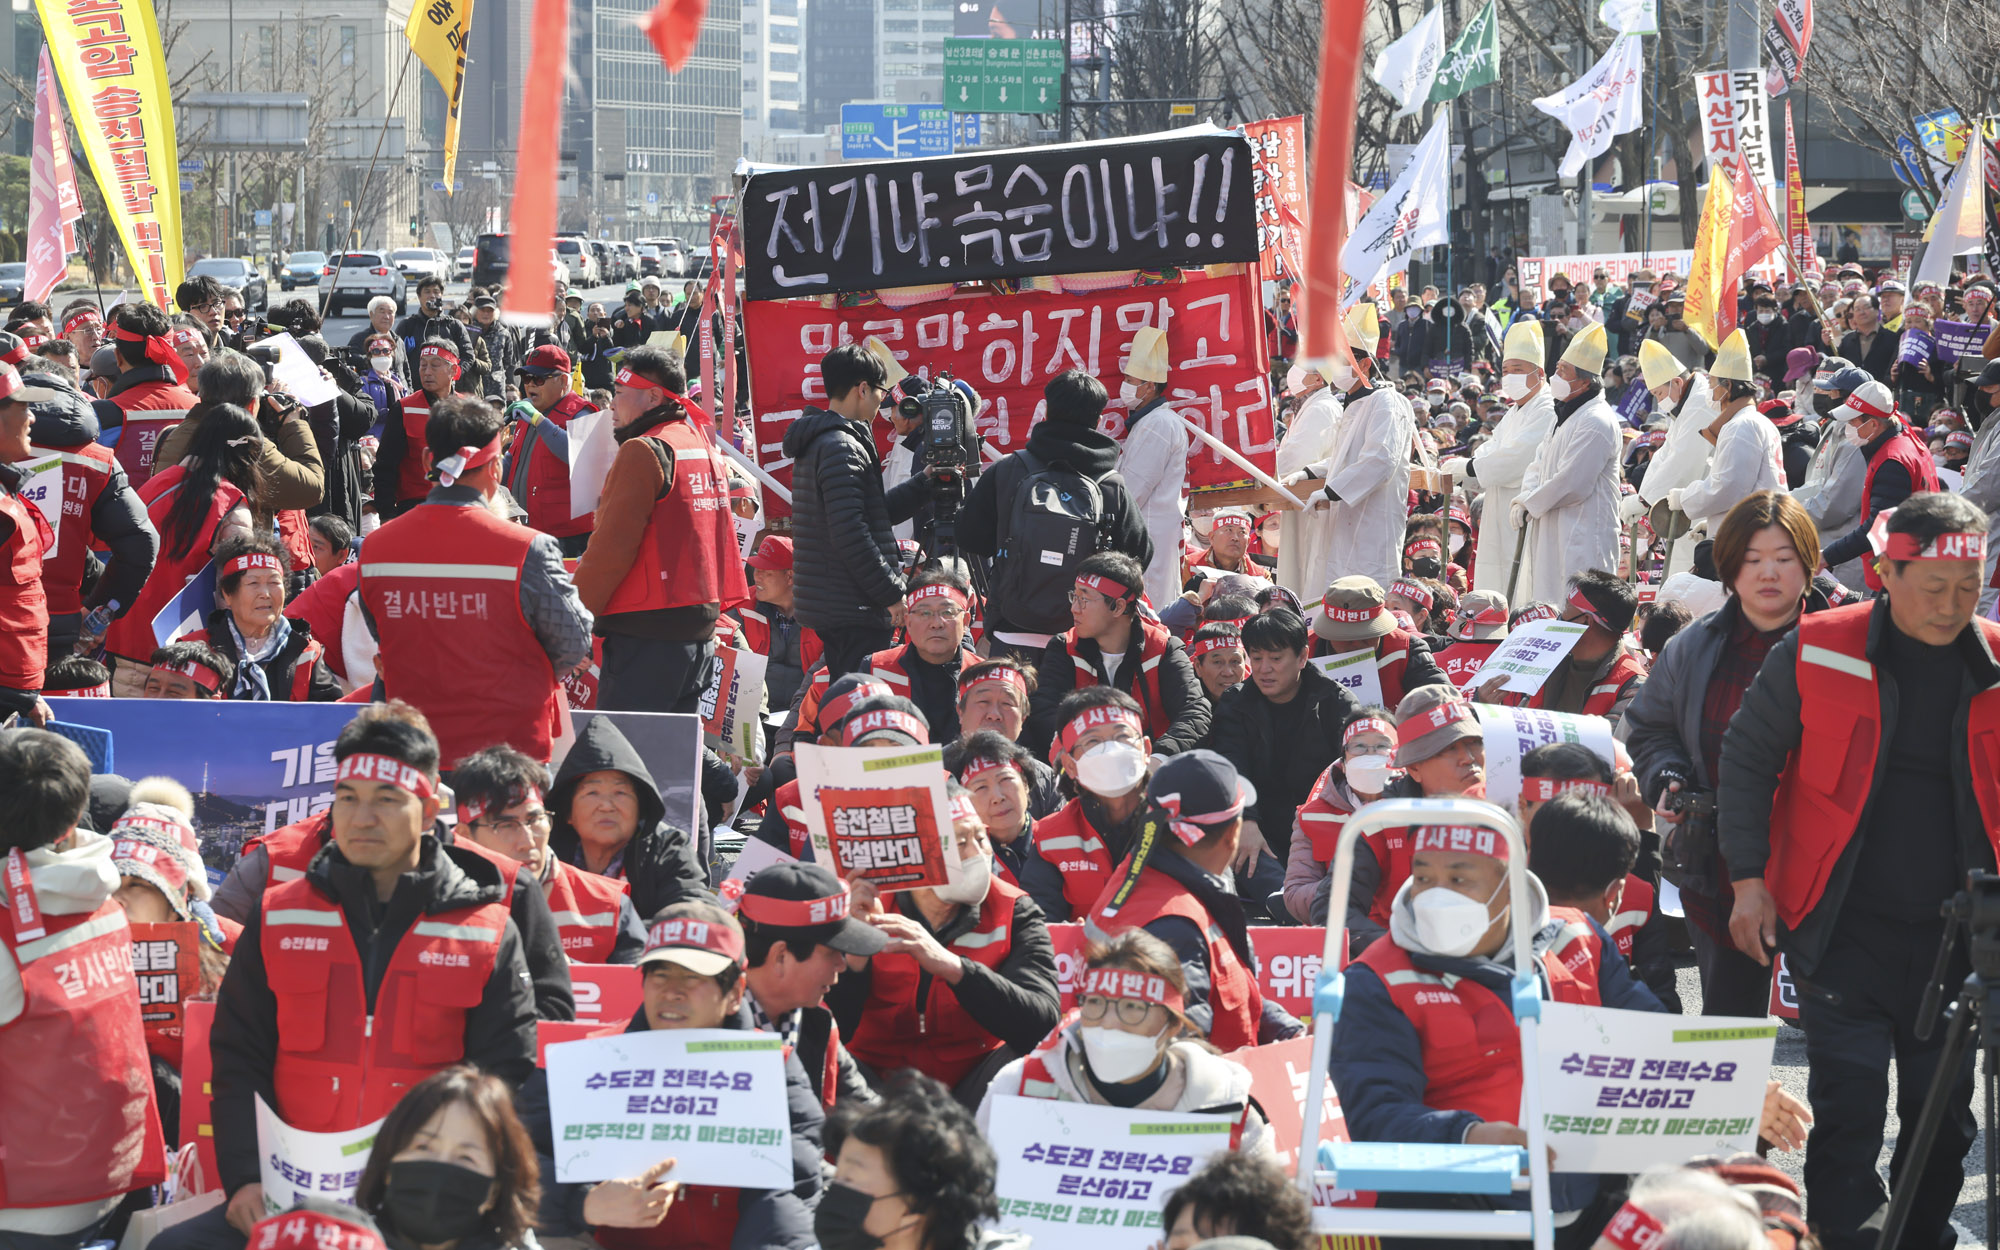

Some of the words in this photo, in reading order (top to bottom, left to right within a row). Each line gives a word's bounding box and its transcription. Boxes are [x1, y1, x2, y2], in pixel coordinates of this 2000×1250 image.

[1734, 72, 1766, 177] 국가산단
[92, 86, 158, 215] 송전철탑
[765, 171, 951, 288] 전기냐.
[952, 147, 1235, 268] 목숨이냐!!
[1067, 527, 1079, 556] THULE
[383, 589, 488, 621] 결사반대
[1328, 607, 1370, 622] 결사반대
[849, 711, 918, 733] 결사반대
[1072, 706, 1140, 737] 결사반대
[832, 805, 918, 837] 송전철탑
[836, 837, 924, 870] 건설반대
[585, 1069, 656, 1090] 수도권
[662, 1069, 754, 1091] 전력수요
[1560, 1052, 1636, 1080] 수도권
[1639, 1059, 1738, 1082] 전력수요
[626, 1095, 719, 1116] 분산하고
[1596, 1086, 1696, 1109] 분산하고
[562, 1123, 646, 1142] 민주적인
[650, 1124, 692, 1142] 절차
[696, 1125, 785, 1147] 마련하라!
[1615, 1116, 1661, 1136] 절차
[1662, 1117, 1755, 1136] 마련하라!
[270, 1153, 313, 1189] 수도권
[1021, 1142, 1094, 1169] 수도권
[1098, 1150, 1194, 1176] 전력수요
[1056, 1174, 1153, 1201] 분산하고
[1076, 1206, 1120, 1227] 절차
